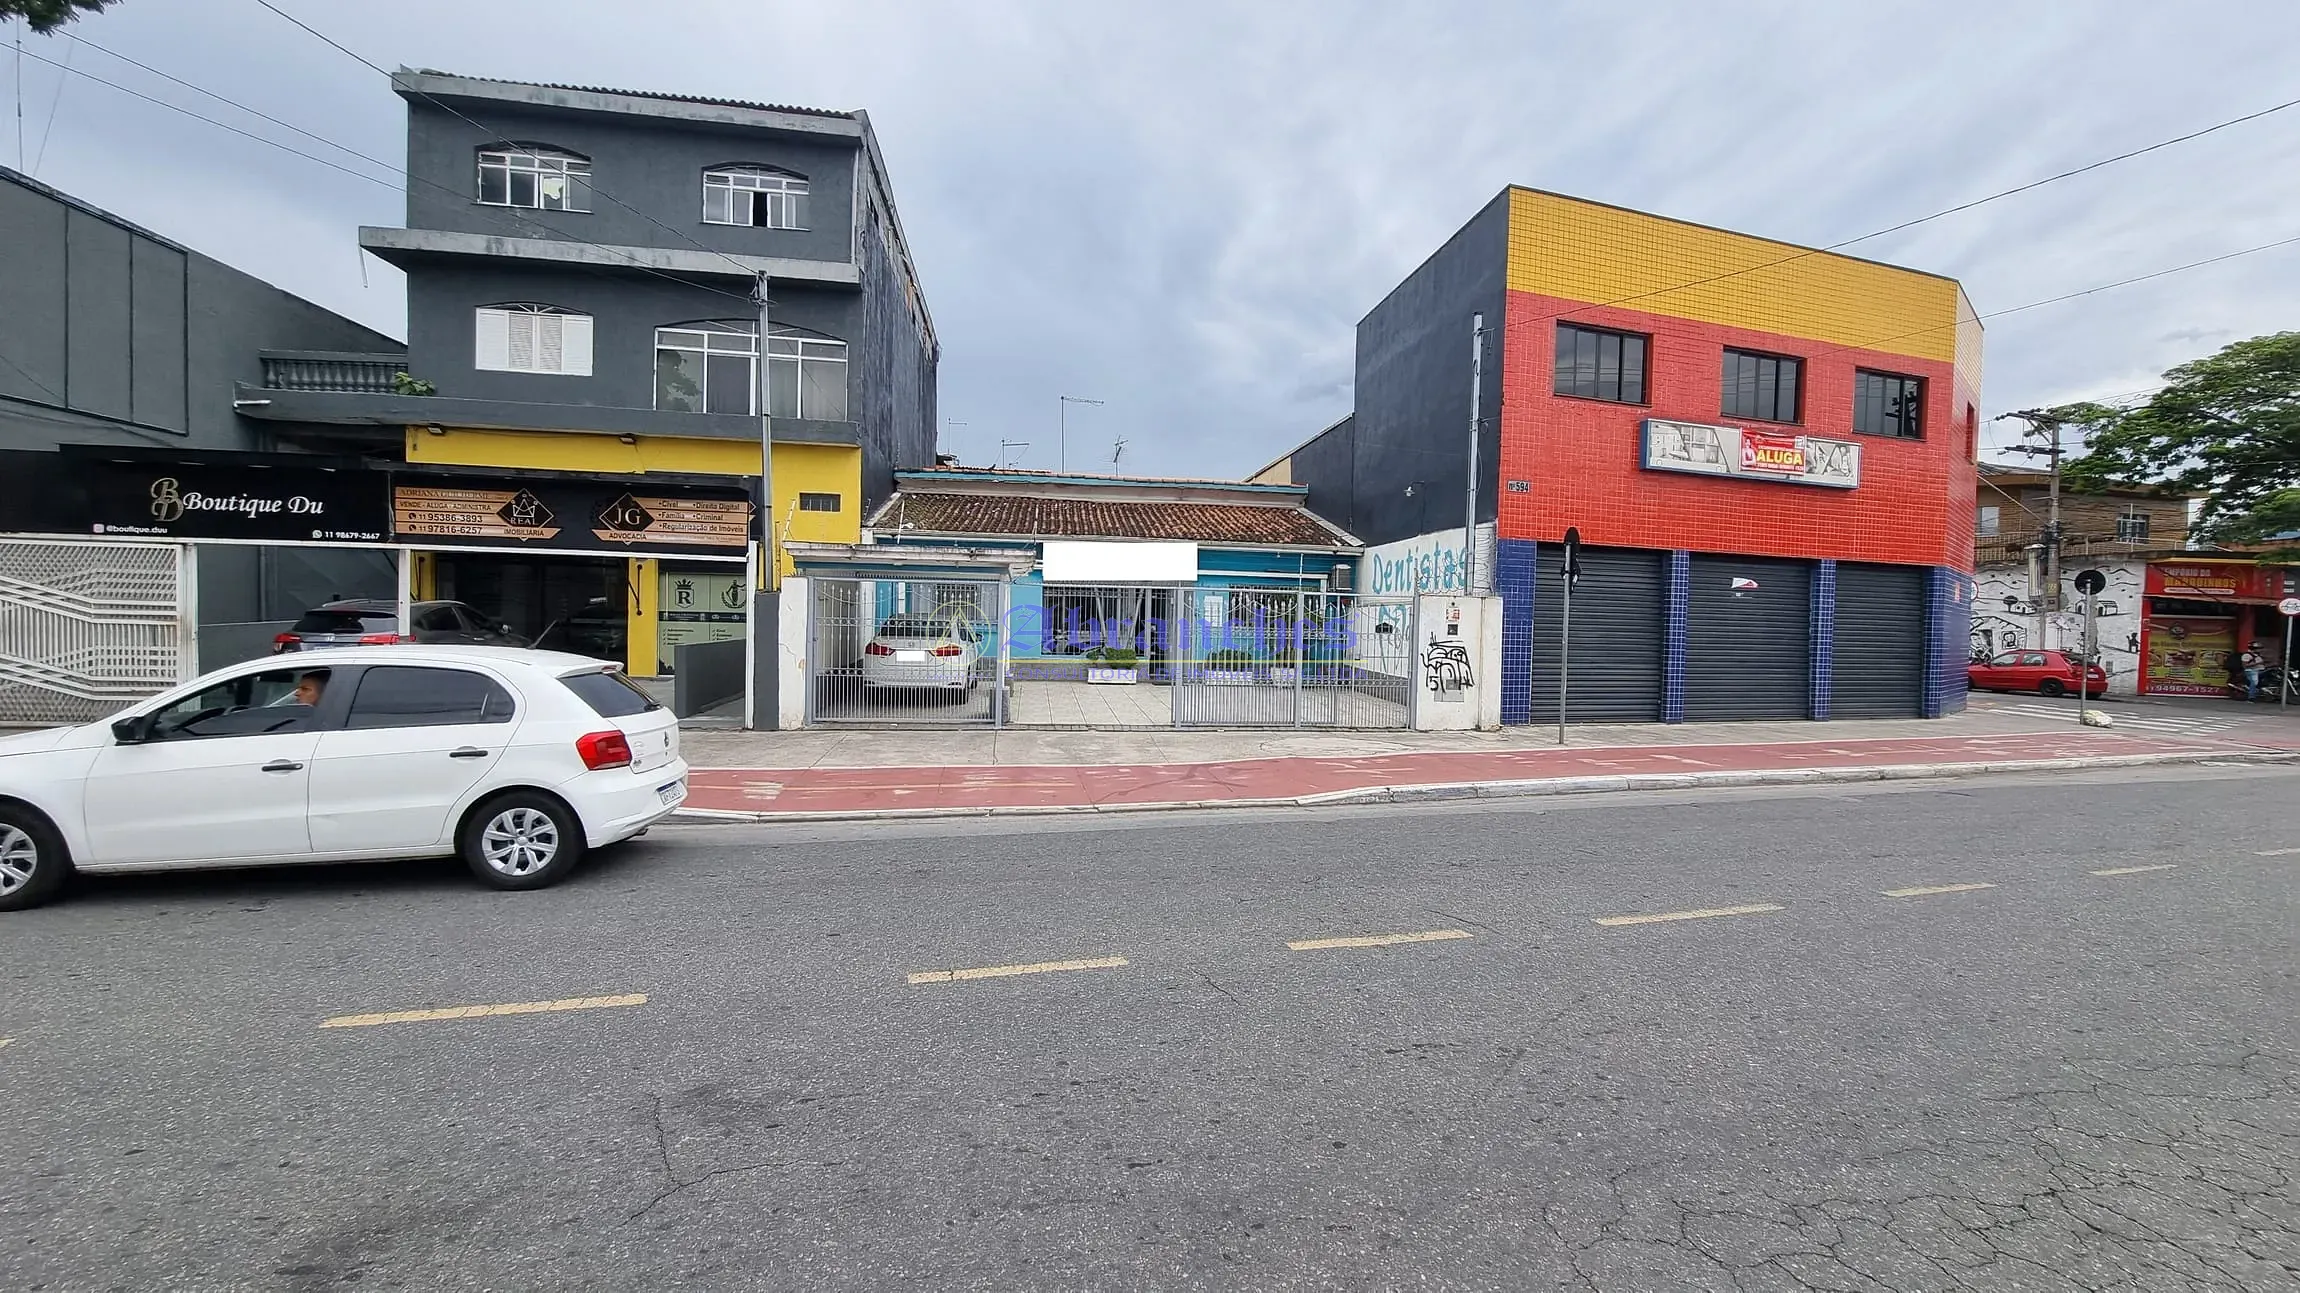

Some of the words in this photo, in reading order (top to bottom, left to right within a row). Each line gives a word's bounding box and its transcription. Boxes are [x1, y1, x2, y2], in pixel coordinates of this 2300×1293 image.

[1756, 449, 1803, 465] ALUGA
[183, 492, 282, 518] Boutique
[288, 496, 324, 514] Du
[718, 503, 740, 511] Digital
[427, 512, 483, 523] 95386-3893
[614, 505, 641, 525] JG
[696, 513, 724, 521] Criminal
[510, 516, 539, 525] REAL
[427, 525, 483, 535] 97816-6257
[609, 532, 647, 540] ADVOCACIA
